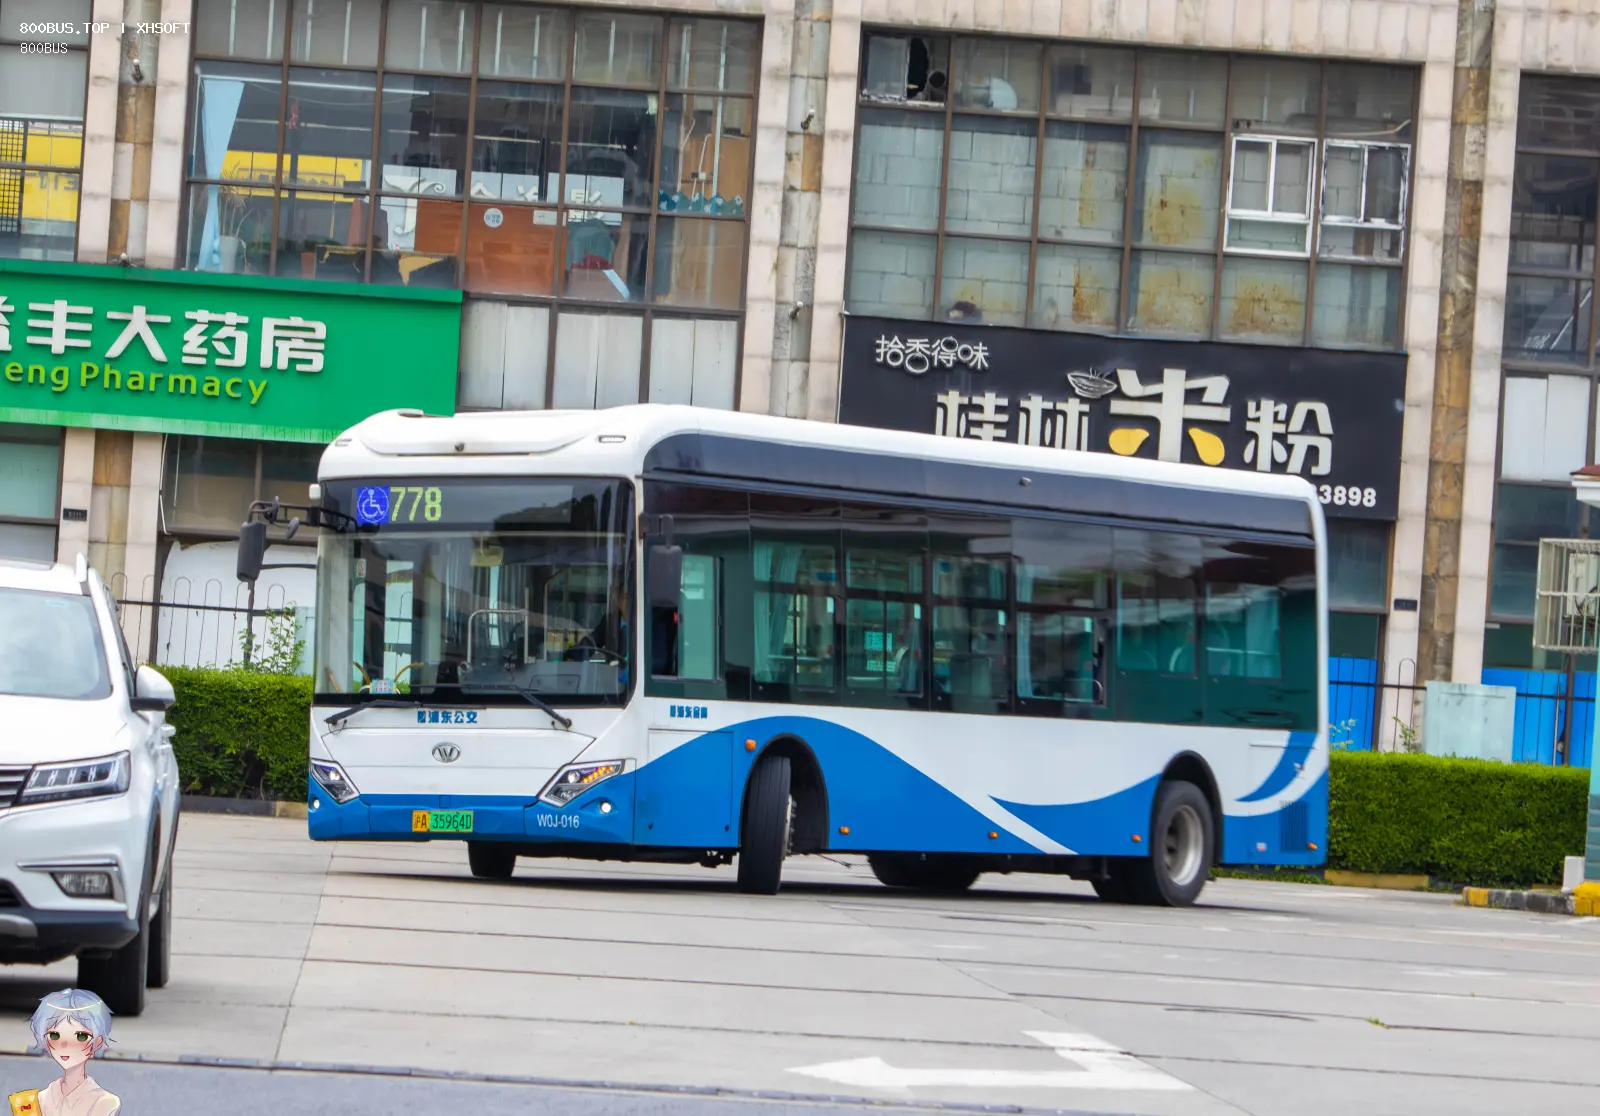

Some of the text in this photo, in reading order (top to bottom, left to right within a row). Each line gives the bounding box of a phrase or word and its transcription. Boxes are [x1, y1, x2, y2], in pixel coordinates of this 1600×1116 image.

[0, 296, 327, 373] 丰大药房
[875, 334, 989, 374] 拾香得味
[80, 361, 268, 405] Pharmacy
[935, 368, 1334, 477] 桂林米粉
[390, 486, 442, 522] 778
[1313, 484, 1377, 508] 3898
